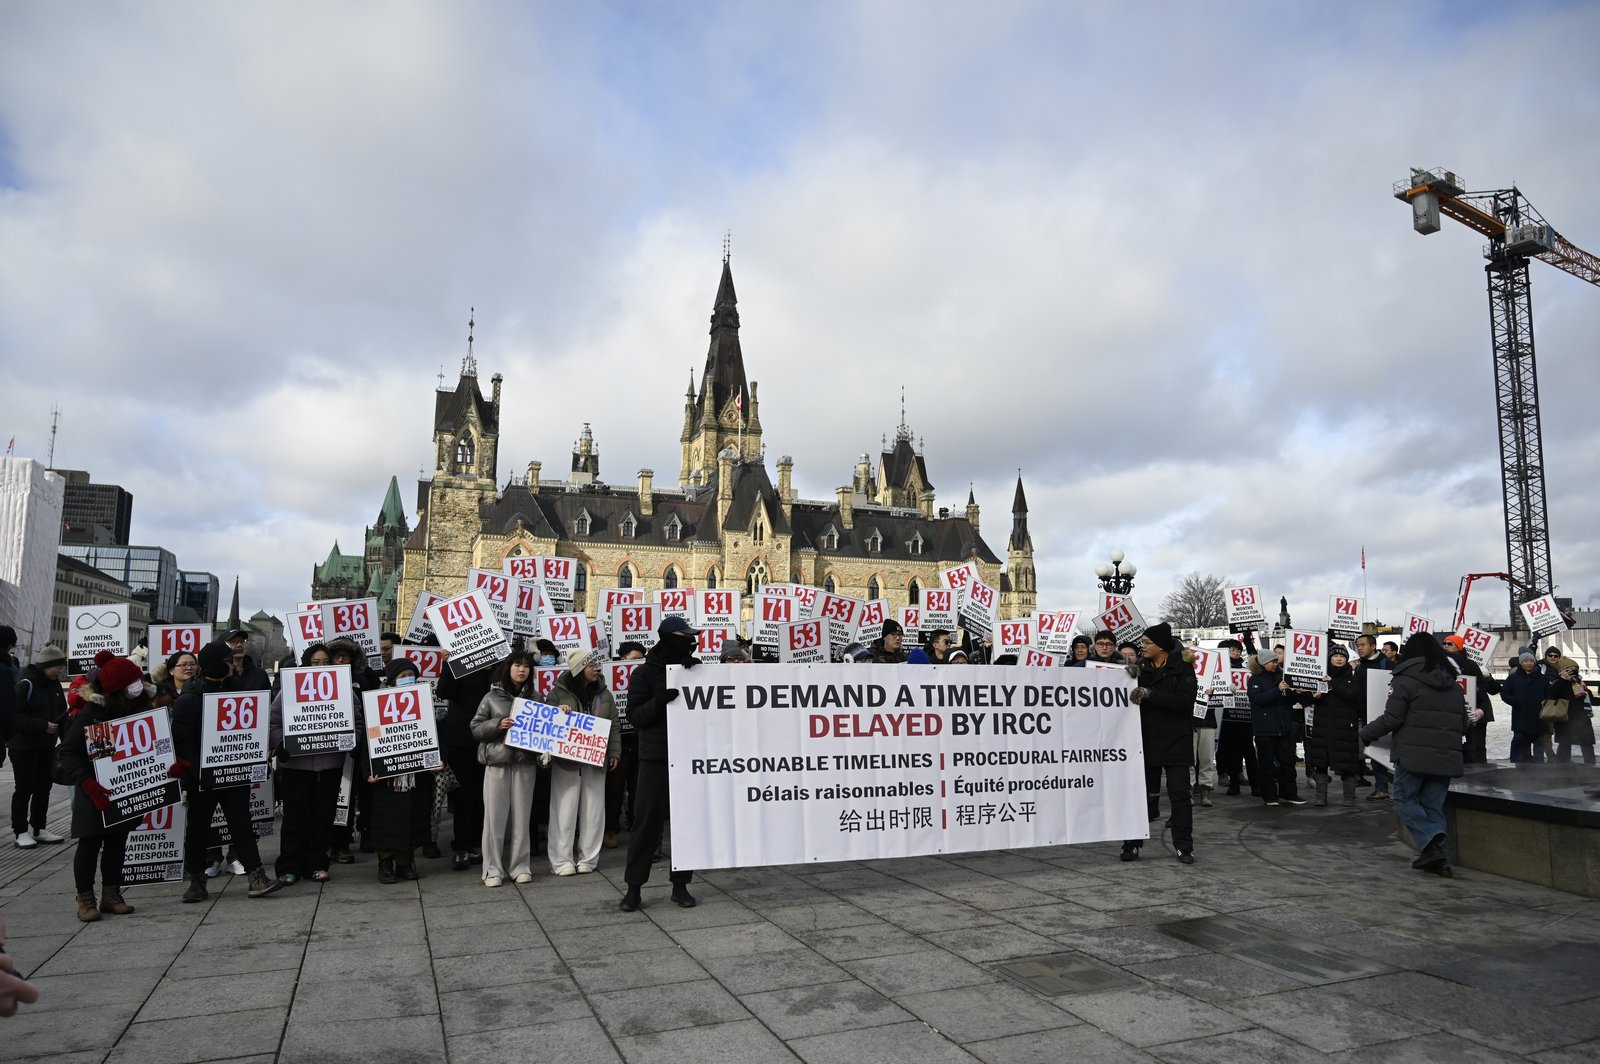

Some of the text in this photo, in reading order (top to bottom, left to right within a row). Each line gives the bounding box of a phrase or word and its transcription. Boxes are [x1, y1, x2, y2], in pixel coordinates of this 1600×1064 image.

[513, 560, 534, 578] 25
[546, 560, 565, 579] 31
[482, 576, 505, 601] 42
[800, 589, 815, 607] 25
[973, 584, 991, 606] 33
[1234, 588, 1253, 605] 38
[664, 592, 684, 610] 22
[708, 594, 729, 613] 31
[767, 599, 787, 621] 71
[826, 598, 851, 622] 53
[929, 593, 948, 610] 34
[971, 602, 988, 614] MONTHS
[1339, 600, 1355, 615] 27
[1530, 600, 1549, 616] 22
[338, 605, 365, 632] 36
[447, 598, 478, 630] 40
[626, 608, 648, 631] 31
[861, 603, 880, 626] 25
[966, 605, 982, 617] WAITING
[971, 612, 992, 627] RESPONSE
[1106, 607, 1129, 629] 34
[454, 624, 483, 639] MONTHS
[553, 618, 578, 640] 22
[1059, 614, 1071, 632] 46
[1114, 623, 1134, 635] MONTHS
[1412, 617, 1428, 633] 30
[167, 629, 195, 655] 19
[450, 628, 493, 649] WAITING FOR
[702, 629, 723, 653] 15
[794, 623, 818, 649] 53
[1004, 624, 1027, 645] 34
[1465, 630, 1488, 649] 35
[72, 649, 88, 657] IRCC
[450, 633, 500, 658] IRCC RESPONSE
[793, 649, 818, 658] MONTHS
[1296, 635, 1317, 655] 24
[410, 650, 437, 677] 32
[1296, 656, 1316, 664] MONTHS
[300, 672, 334, 701] 40
[682, 684, 1129, 710] WE DEMAND A TIMELY DECISION
[221, 697, 254, 730] 36
[293, 711, 344, 722] WAITING FOR
[302, 704, 335, 713] MONTHS
[384, 692, 417, 723] 42
[522, 701, 595, 731] STOP THE
[289, 720, 349, 732] IRCC RESPONSE
[385, 723, 418, 734] MONTHS
[809, 713, 1052, 738] DELAYED BY IRCC
[115, 719, 152, 757] 40
[220, 733, 252, 743] MONTHS
[374, 738, 433, 754] IRCC RESPONSE
[378, 730, 427, 745] WAITING FOR
[206, 751, 264, 764] IRCC RESPONSE
[212, 742, 260, 754] WAITING FOR
[557, 741, 606, 764] TOGETHER
[953, 748, 1127, 766] PROCEDURAL FAIRNESS
[117, 756, 155, 773] MONTHS
[692, 753, 933, 774] REASONABLE TIMELINES
[110, 763, 166, 786] WAITING FOR
[748, 782, 934, 802] Délais raisonnables
[954, 775, 1094, 795] Équité procédurale
[117, 787, 166, 809] NO TIMELINES
[121, 796, 164, 816] NO RESULTS
[839, 807, 933, 832] 给出时限
[956, 802, 1036, 826] 程序公平
[130, 833, 166, 843] MONTHS
[158, 842, 175, 850] FOR
[135, 850, 179, 861] RESPONSE
